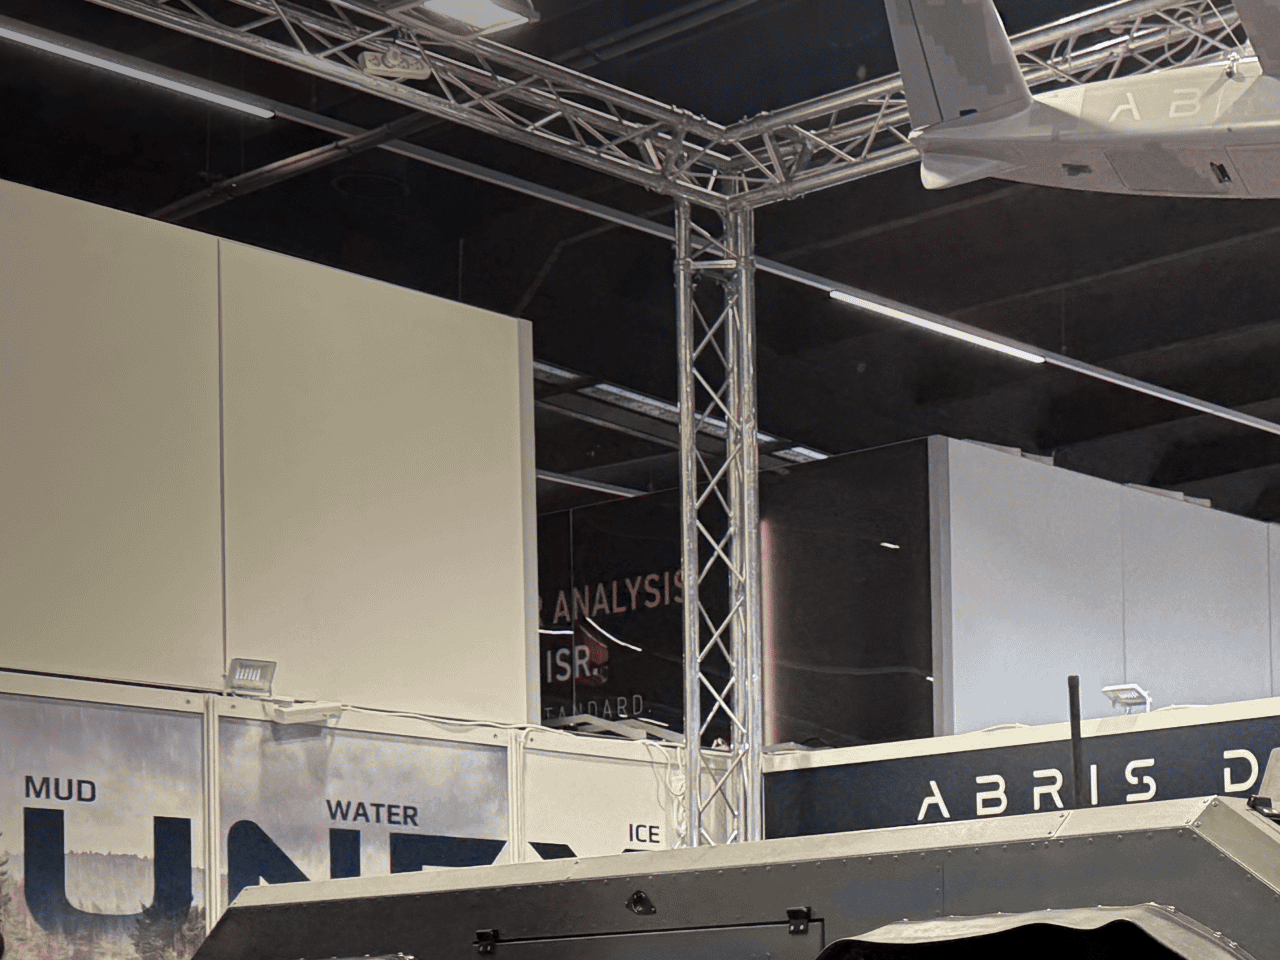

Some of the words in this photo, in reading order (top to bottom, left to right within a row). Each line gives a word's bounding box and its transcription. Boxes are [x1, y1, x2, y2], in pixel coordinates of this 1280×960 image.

[552, 571, 685, 624] ANALYSIS
[24, 775, 97, 803] MUD
[917, 757, 1157, 821] ABRIS
[326, 799, 419, 827] WATER
[628, 823, 661, 844] ICE
